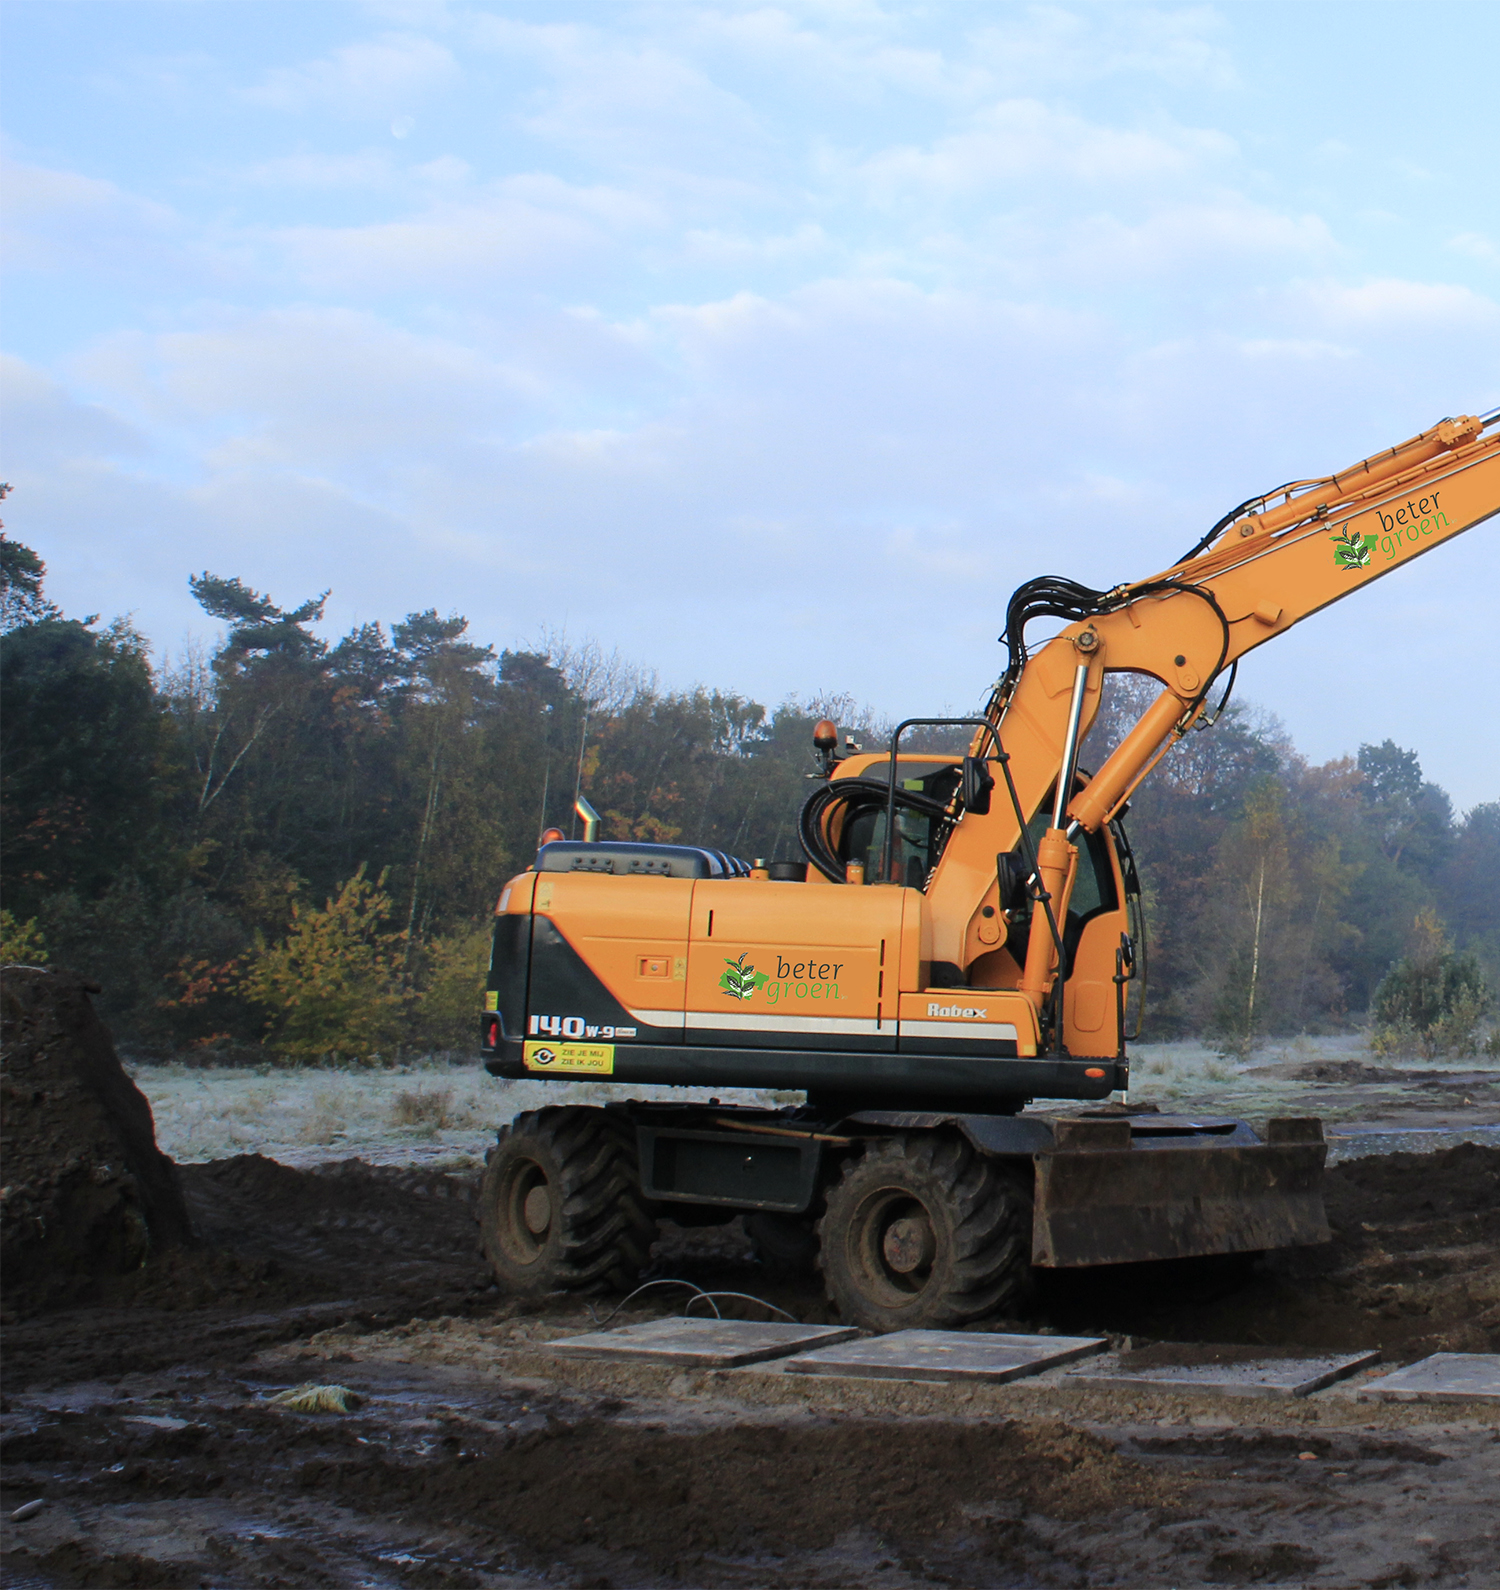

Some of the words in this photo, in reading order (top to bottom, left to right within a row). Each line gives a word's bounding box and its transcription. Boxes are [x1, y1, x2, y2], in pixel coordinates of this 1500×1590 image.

[1376, 491, 1440, 532] beter
[1381, 511, 1449, 560] groen
[777, 955, 844, 980] beter
[766, 981, 840, 1005] groen
[927, 1003, 988, 1018] Robex
[561, 1058, 574, 1066] ZIE
[588, 1059, 604, 1067] JOU
